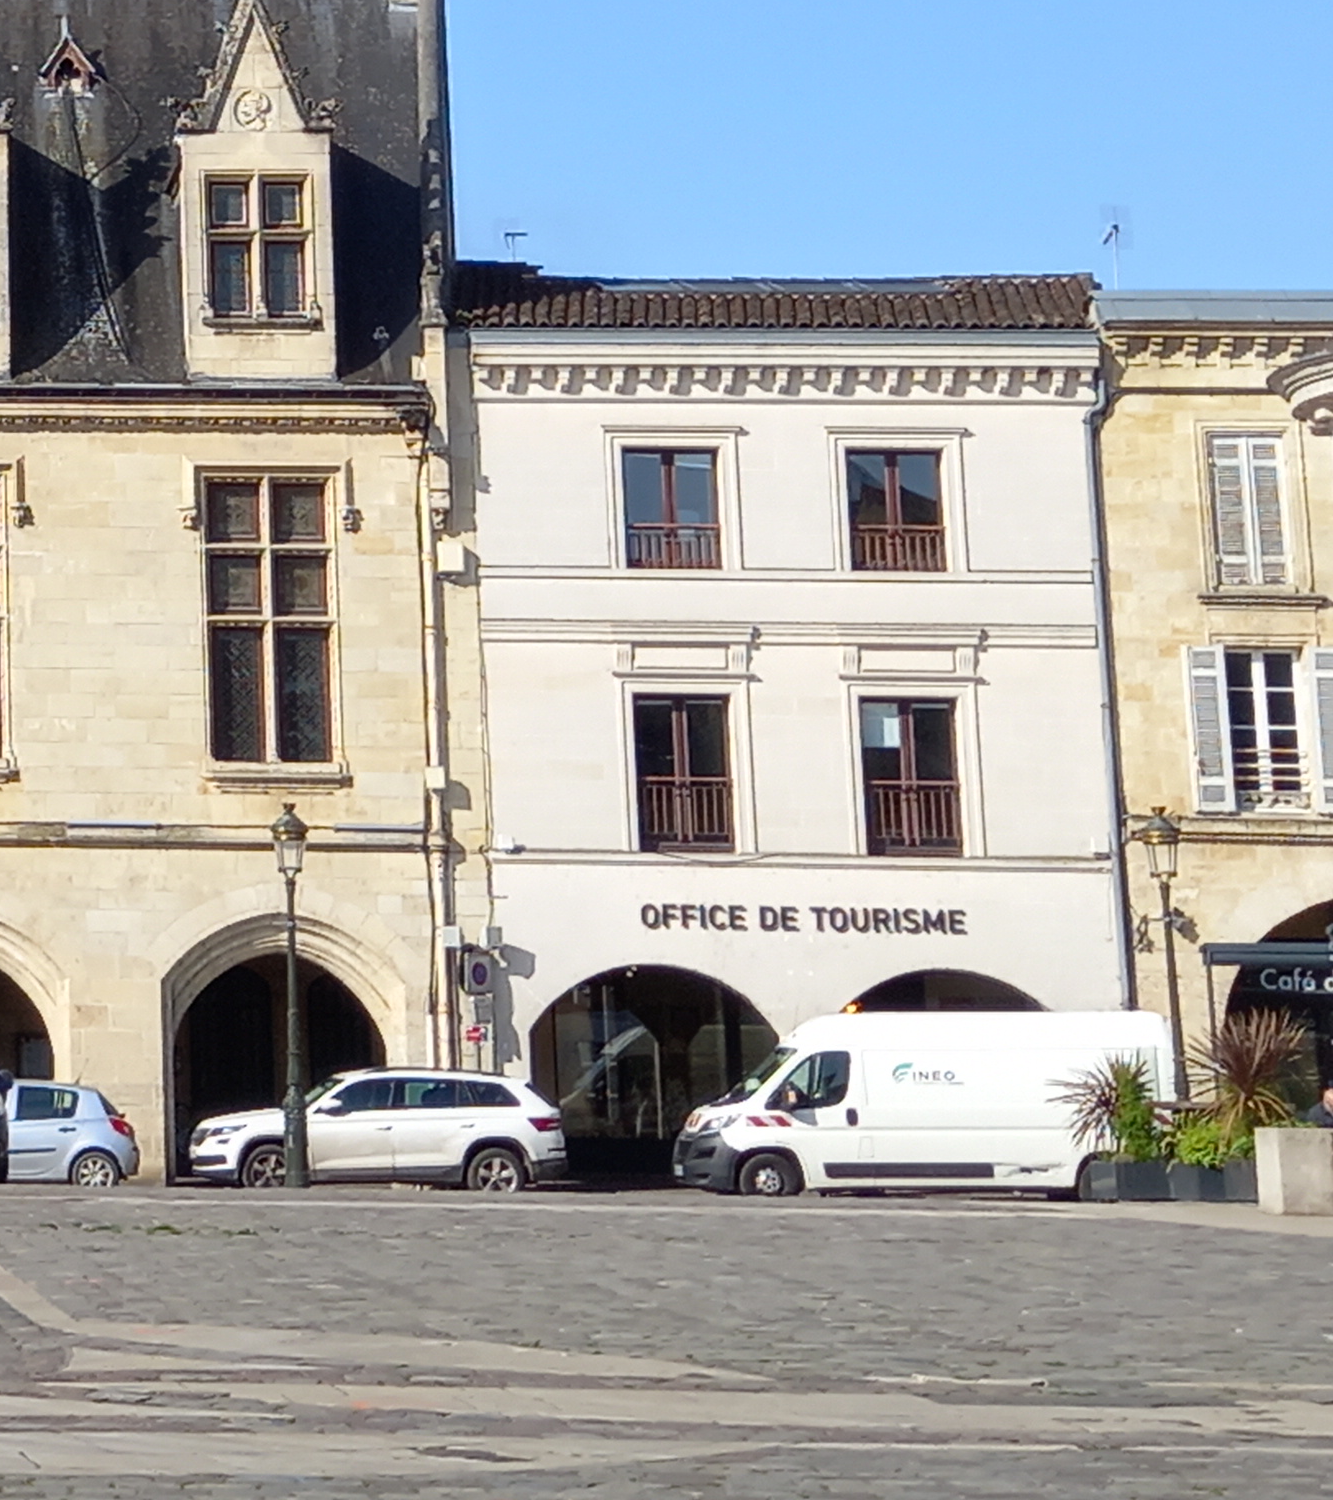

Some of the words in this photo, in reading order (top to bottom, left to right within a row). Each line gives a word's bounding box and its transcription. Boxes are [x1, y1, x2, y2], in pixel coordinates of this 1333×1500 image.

[641, 903, 748, 931] OFFICE
[758, 905, 800, 932] DE
[809, 906, 968, 936] TOURISME
[1259, 967, 1317, 992] Café
[912, 1070, 956, 1082] INEO
